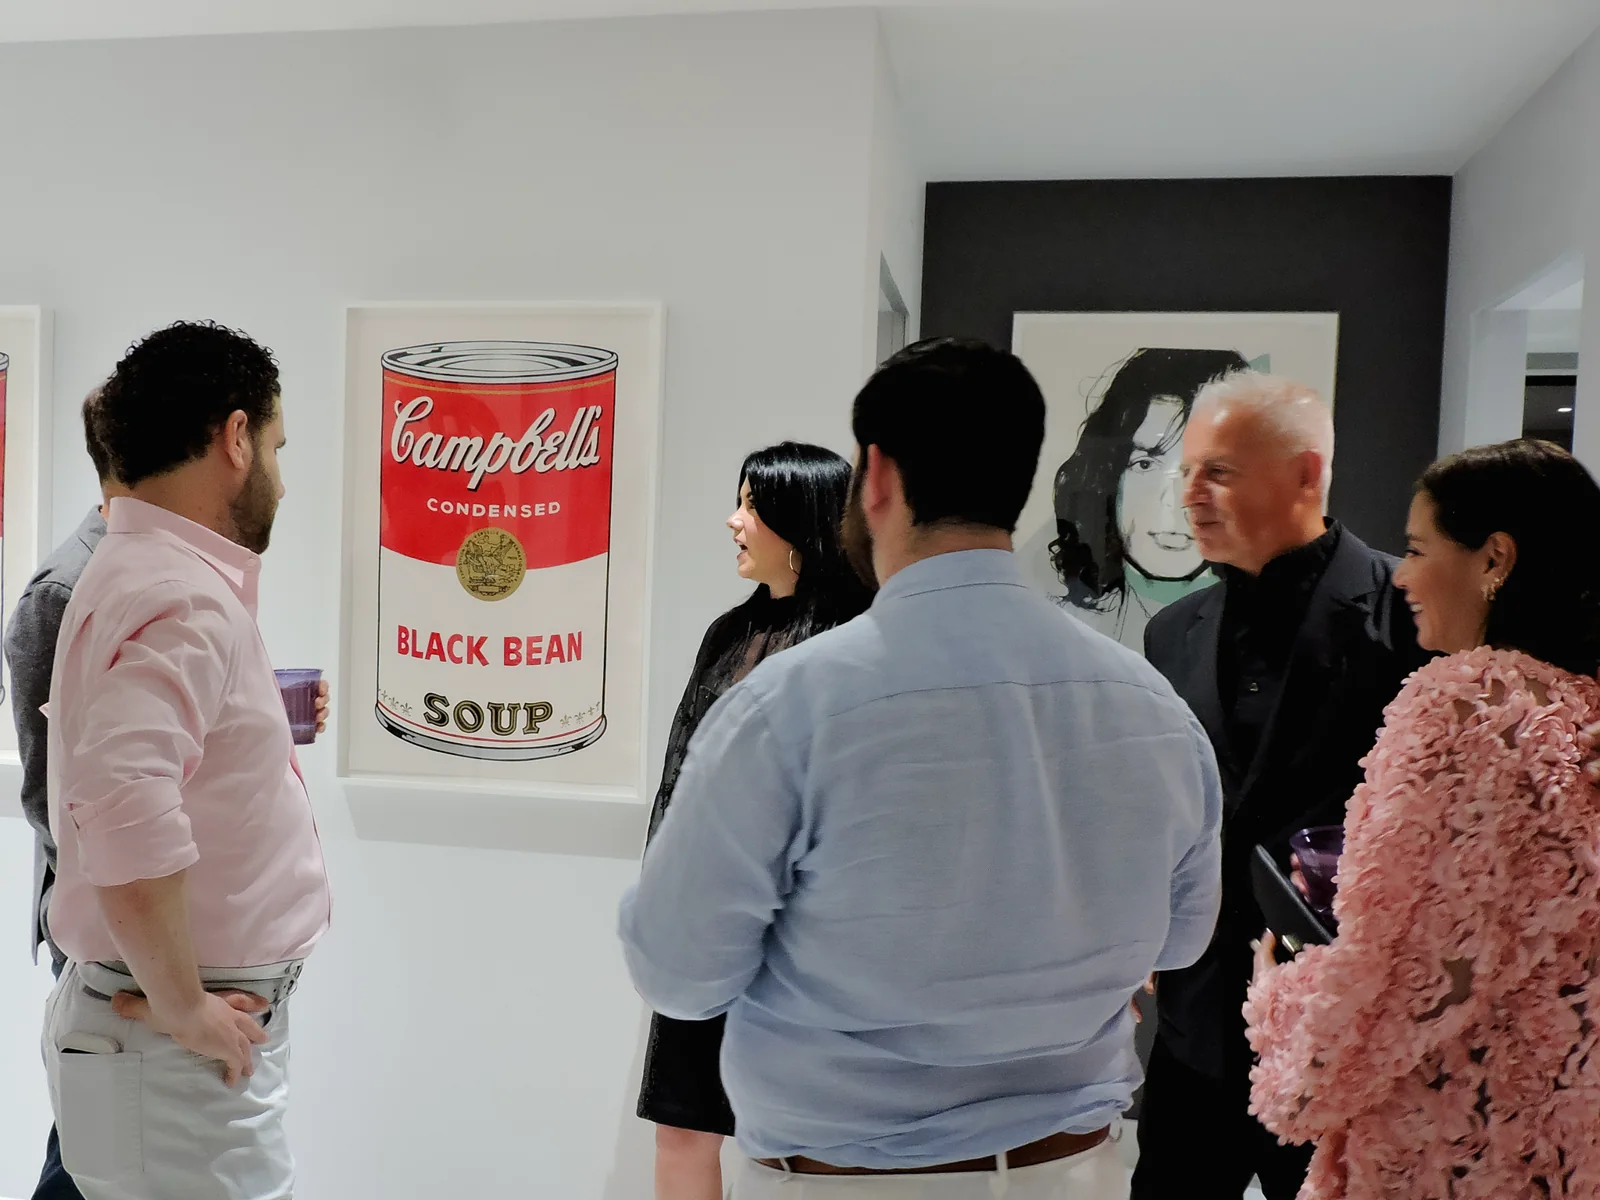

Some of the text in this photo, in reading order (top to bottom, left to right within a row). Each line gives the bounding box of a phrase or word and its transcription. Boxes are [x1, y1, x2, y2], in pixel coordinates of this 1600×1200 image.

[390, 395, 603, 490] Campbell's
[426, 497, 562, 518] CONDENSED
[397, 625, 583, 667] BLACK BEAN
[422, 692, 554, 737] SOUP
